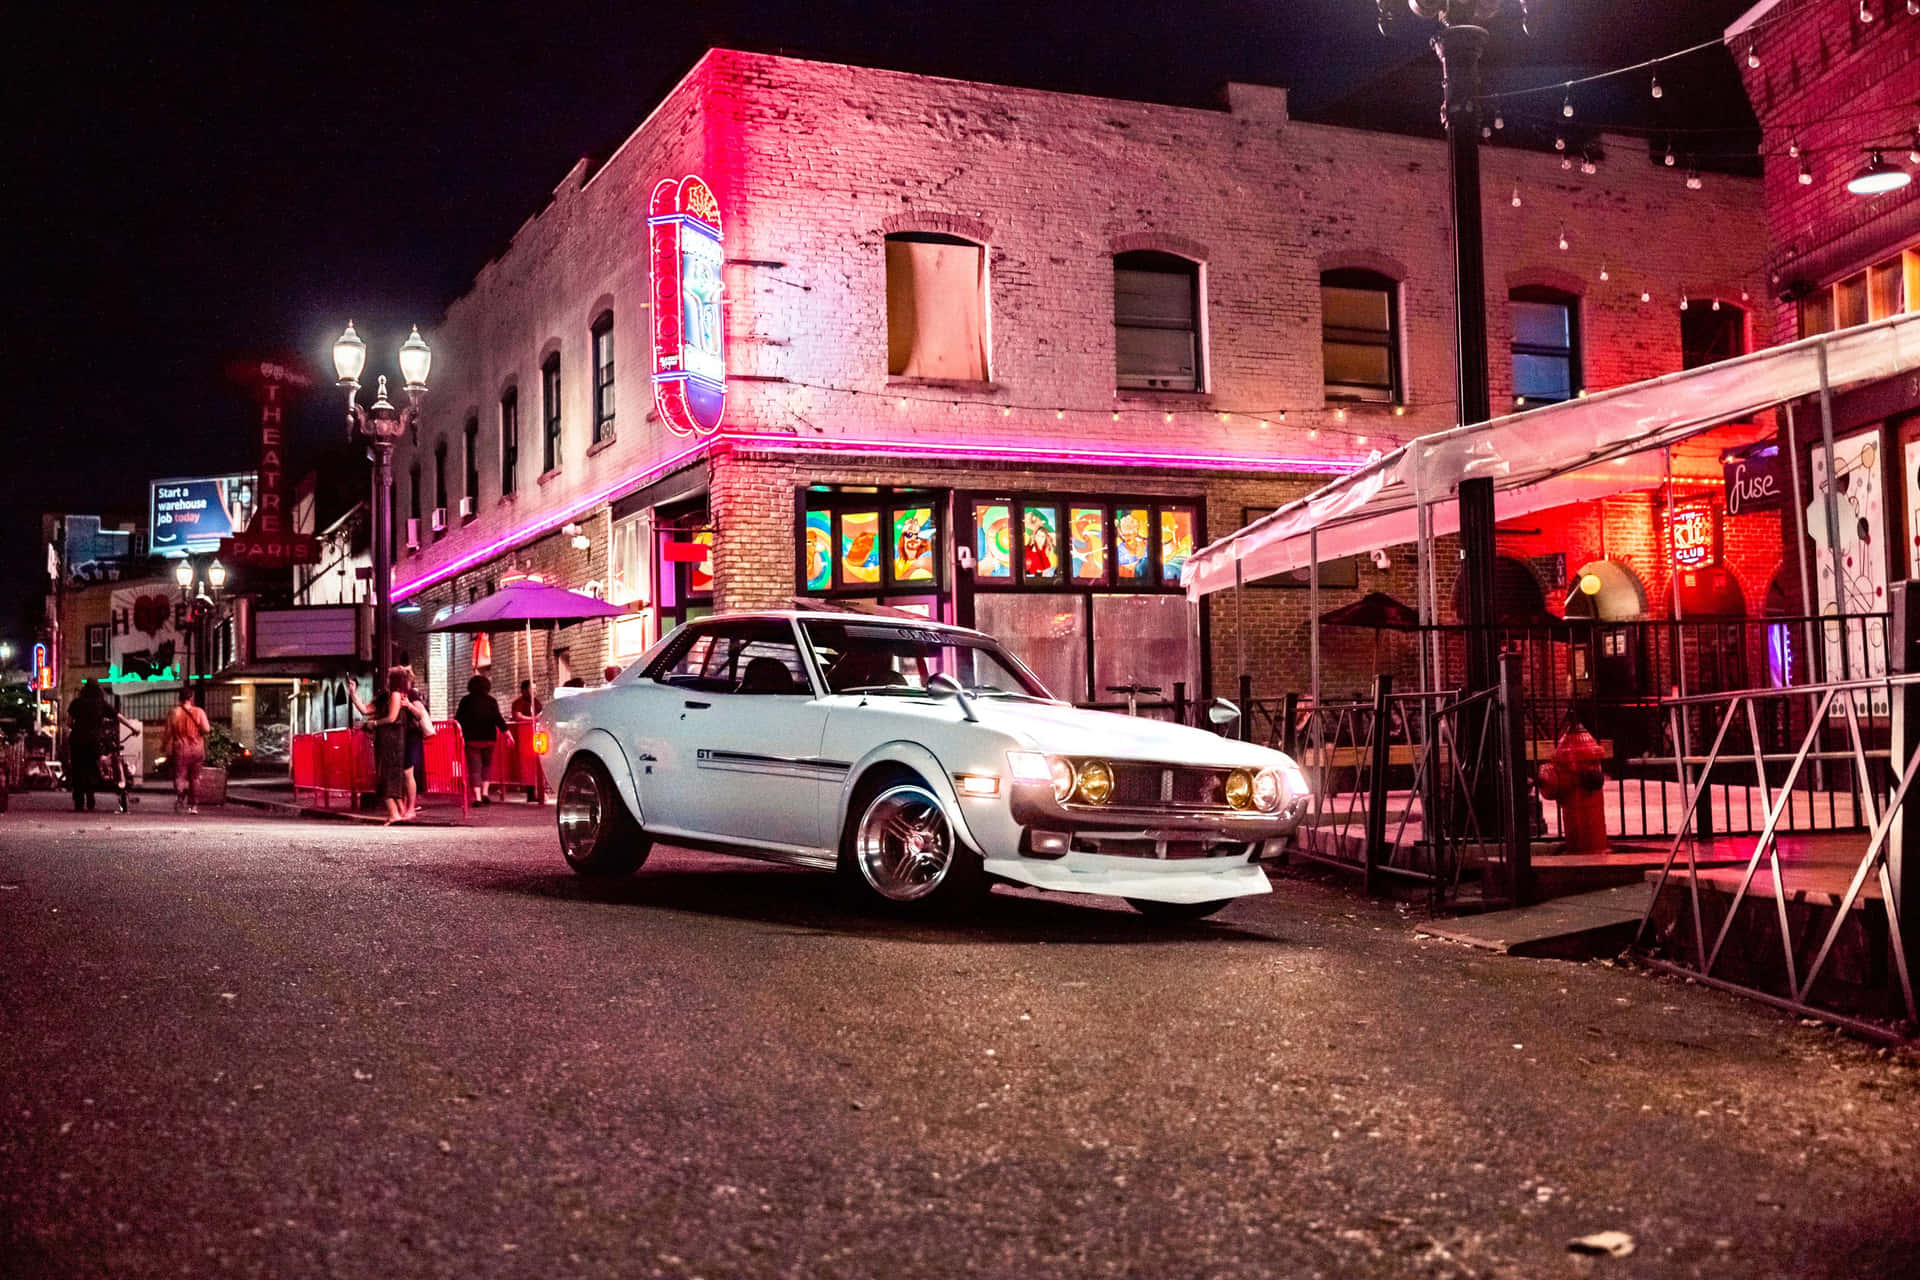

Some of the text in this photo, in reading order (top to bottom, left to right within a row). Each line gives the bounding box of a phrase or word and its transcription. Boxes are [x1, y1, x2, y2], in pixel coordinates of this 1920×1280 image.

[262, 385, 281, 532] THEATRE
[158, 488, 189, 498] Start a
[1730, 464, 1781, 515] fuse
[158, 499, 207, 511] warehouse
[157, 512, 200, 527] job today
[233, 543, 308, 558] PARIS
[1675, 547, 1704, 560] CLUB
[697, 749, 711, 759] GT
